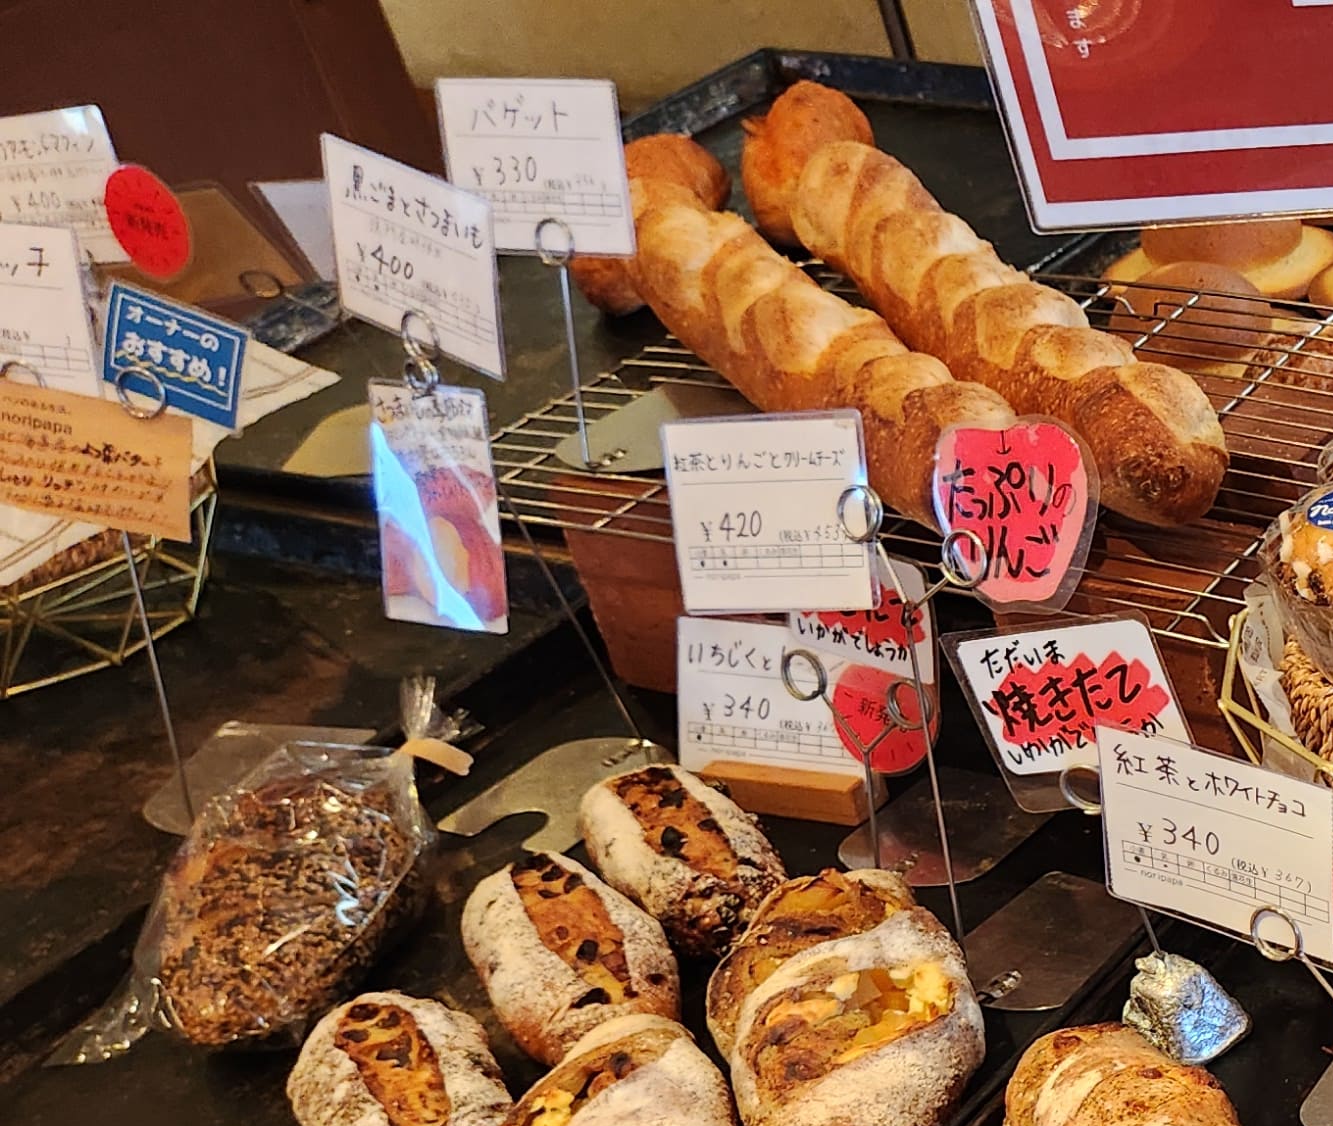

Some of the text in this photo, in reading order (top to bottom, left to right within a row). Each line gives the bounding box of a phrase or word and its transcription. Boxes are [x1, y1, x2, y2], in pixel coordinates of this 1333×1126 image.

[472, 94, 568, 131] バゲット
[357, 242, 414, 279] ¥400
[127, 304, 219, 352] オーナーの
[122, 331, 227, 387] おすすめ!
[1, 411, 72, 436] noripapa
[673, 449, 846, 472] 紅茶とりんごとクリームチーズ
[700, 511, 762, 542] ¥420
[968, 525, 1059, 580] りんご
[981, 640, 1065, 678] ただいま
[703, 694, 771, 721] ¥340
[858, 697, 908, 732] 新発
[983, 664, 1142, 736] 焼きたて
[1009, 712, 1164, 764] いかがでか
[1113, 743, 1306, 817] 紅茶とホワイトチョコ
[1137, 818, 1220, 855] ¥340
[1140, 869, 1184, 887] noripapa
